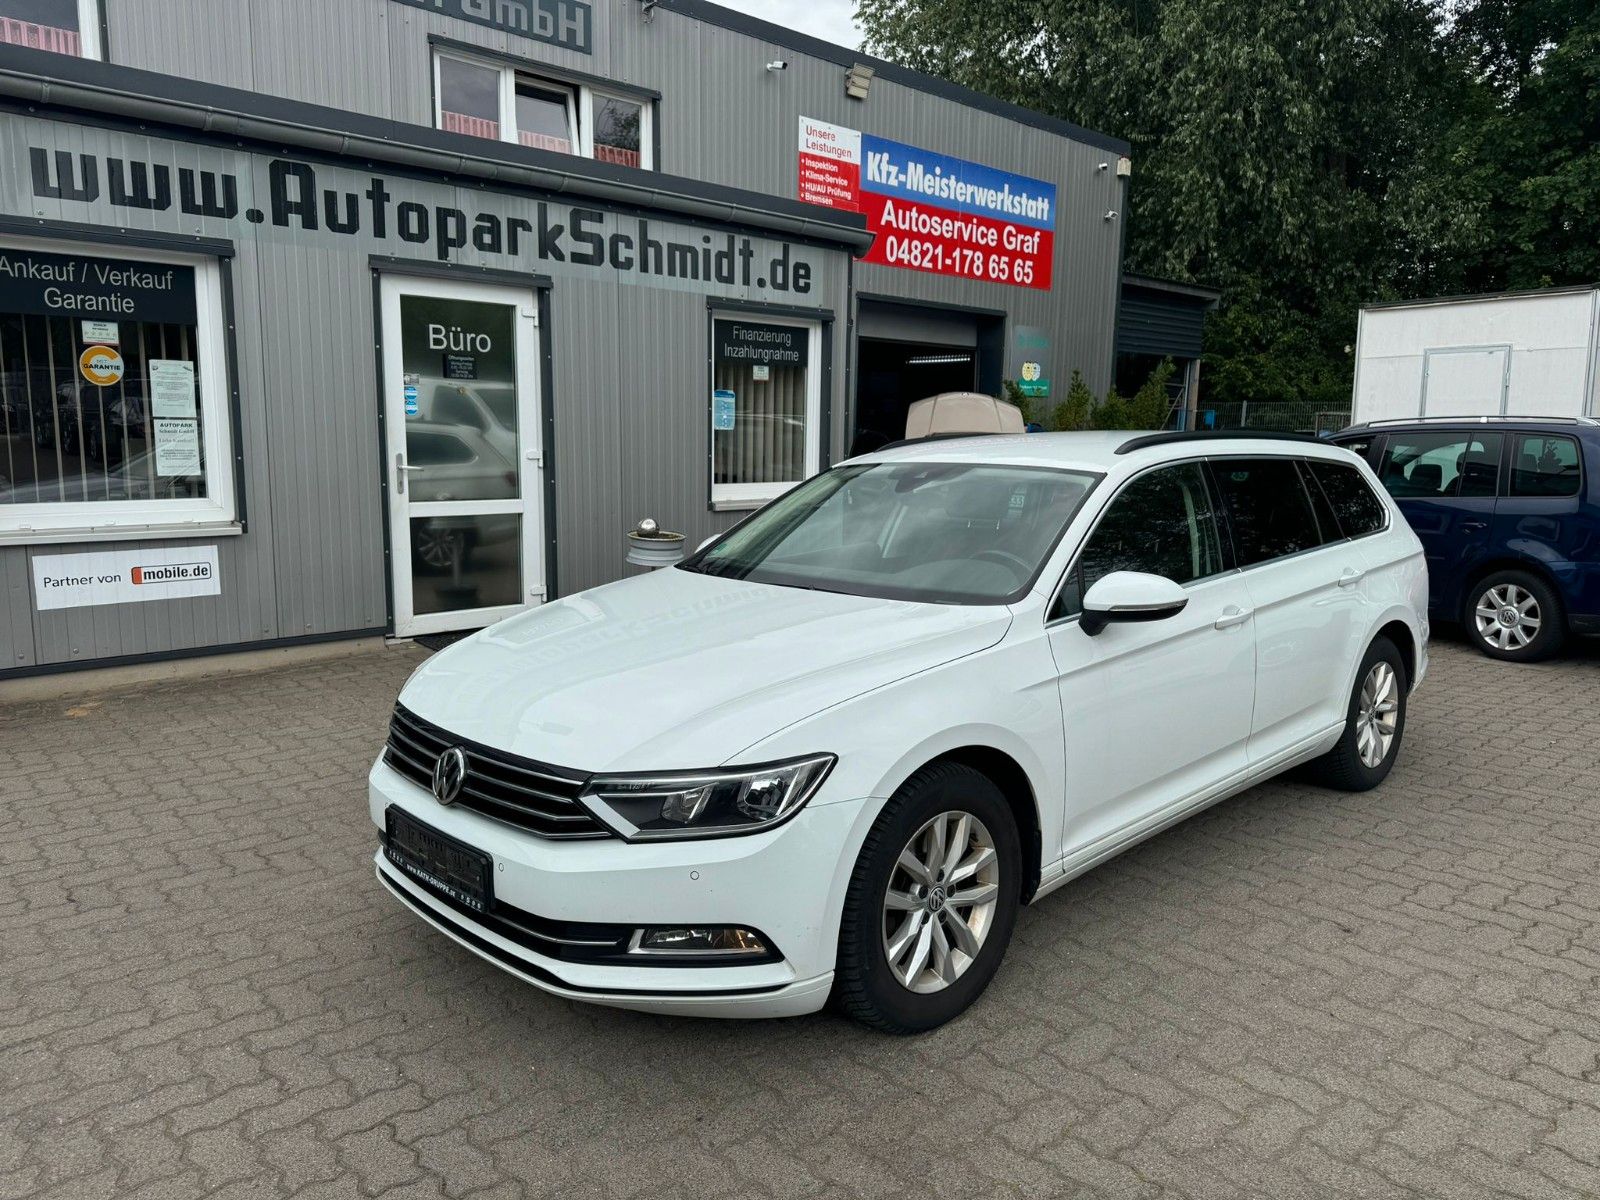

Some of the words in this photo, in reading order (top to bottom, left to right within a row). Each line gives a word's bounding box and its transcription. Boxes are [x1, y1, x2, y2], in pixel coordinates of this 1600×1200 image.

[806, 124, 836, 142] Unsere
[805, 138, 852, 159] Leistungen
[805, 157, 839, 173] Inspektion
[805, 169, 849, 187] Klima-Service
[867, 150, 1050, 222] Kfz-Meisterwerkstatt
[804, 192, 833, 205] Bremsen
[805, 181, 826, 195] HU/AU
[827, 186, 852, 200] Prüfung
[29, 146, 811, 294] www.AutoparkSchmidt.de
[880, 199, 998, 248] Autoservice
[1002, 225, 1041, 255] Graf
[885, 235, 984, 277] 04821-178
[988, 254, 1009, 281] 65
[1013, 258, 1034, 285] 65
[0, 255, 75, 283] Ankauf
[94, 264, 173, 291] Verkauf
[43, 286, 135, 314] Garantie
[428, 323, 492, 353] Büro
[732, 325, 792, 347] Finanzierung
[724, 342, 800, 362] Inzahlungnahme
[83, 363, 121, 371] GARANTIE
[43, 574, 93, 588] Partner
[97, 574, 121, 584] von
[143, 564, 209, 581] mobile.de
